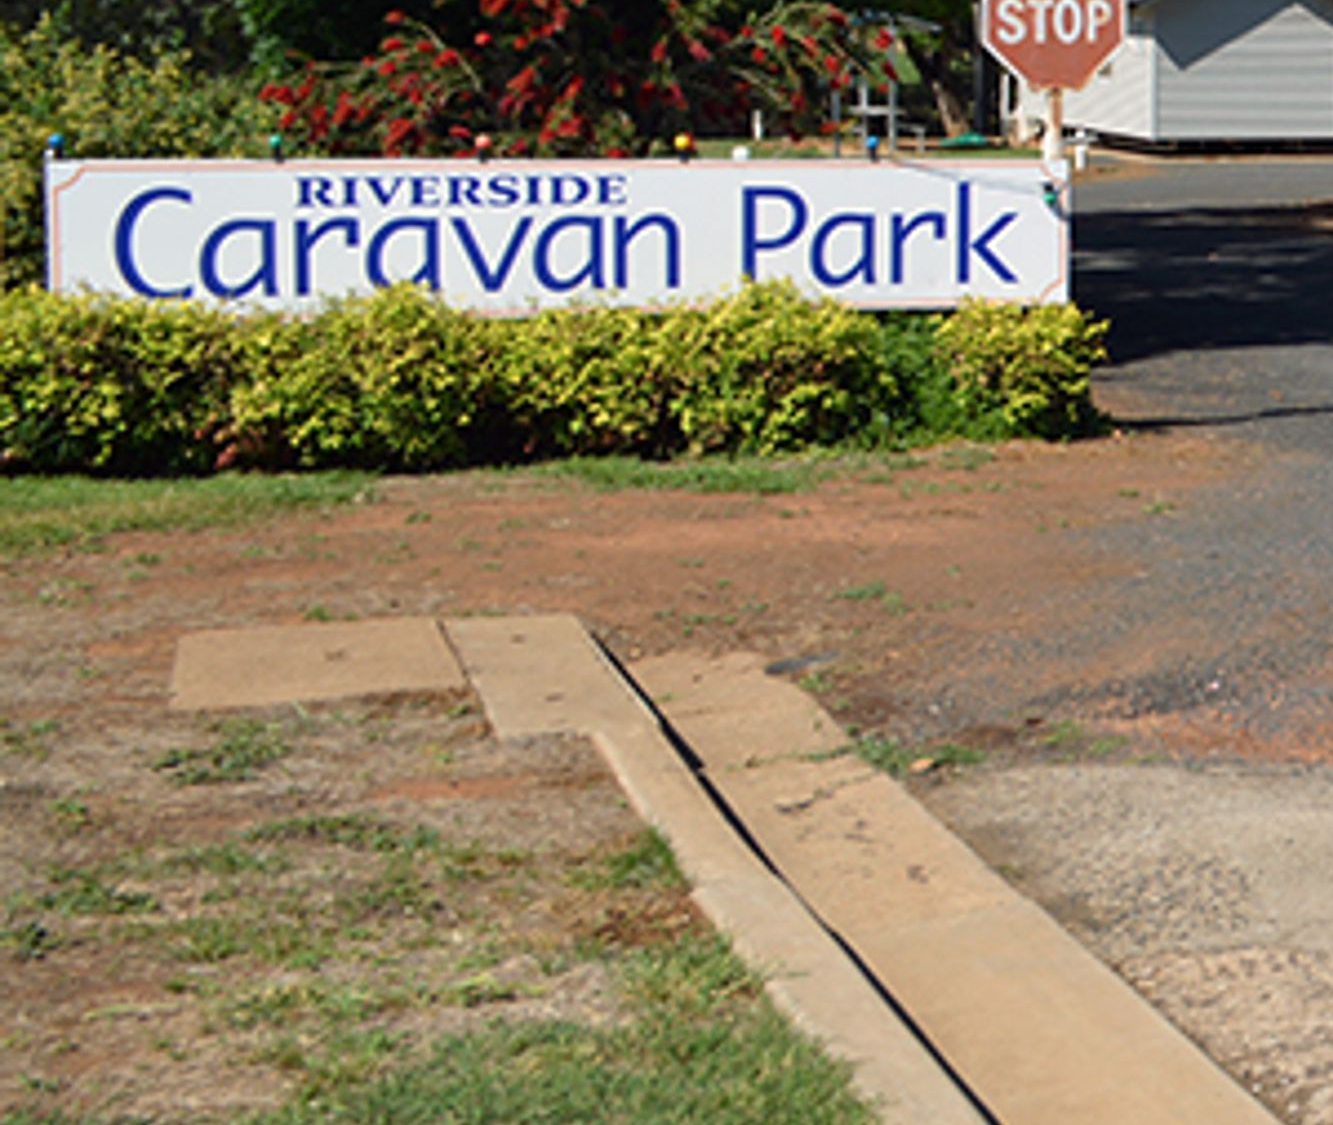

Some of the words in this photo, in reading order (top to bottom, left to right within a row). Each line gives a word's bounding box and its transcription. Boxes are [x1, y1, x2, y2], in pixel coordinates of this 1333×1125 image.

[295, 174, 629, 208] RIVERSIDE
[113, 187, 682, 299] Caravan
[741, 181, 1020, 289] Park
